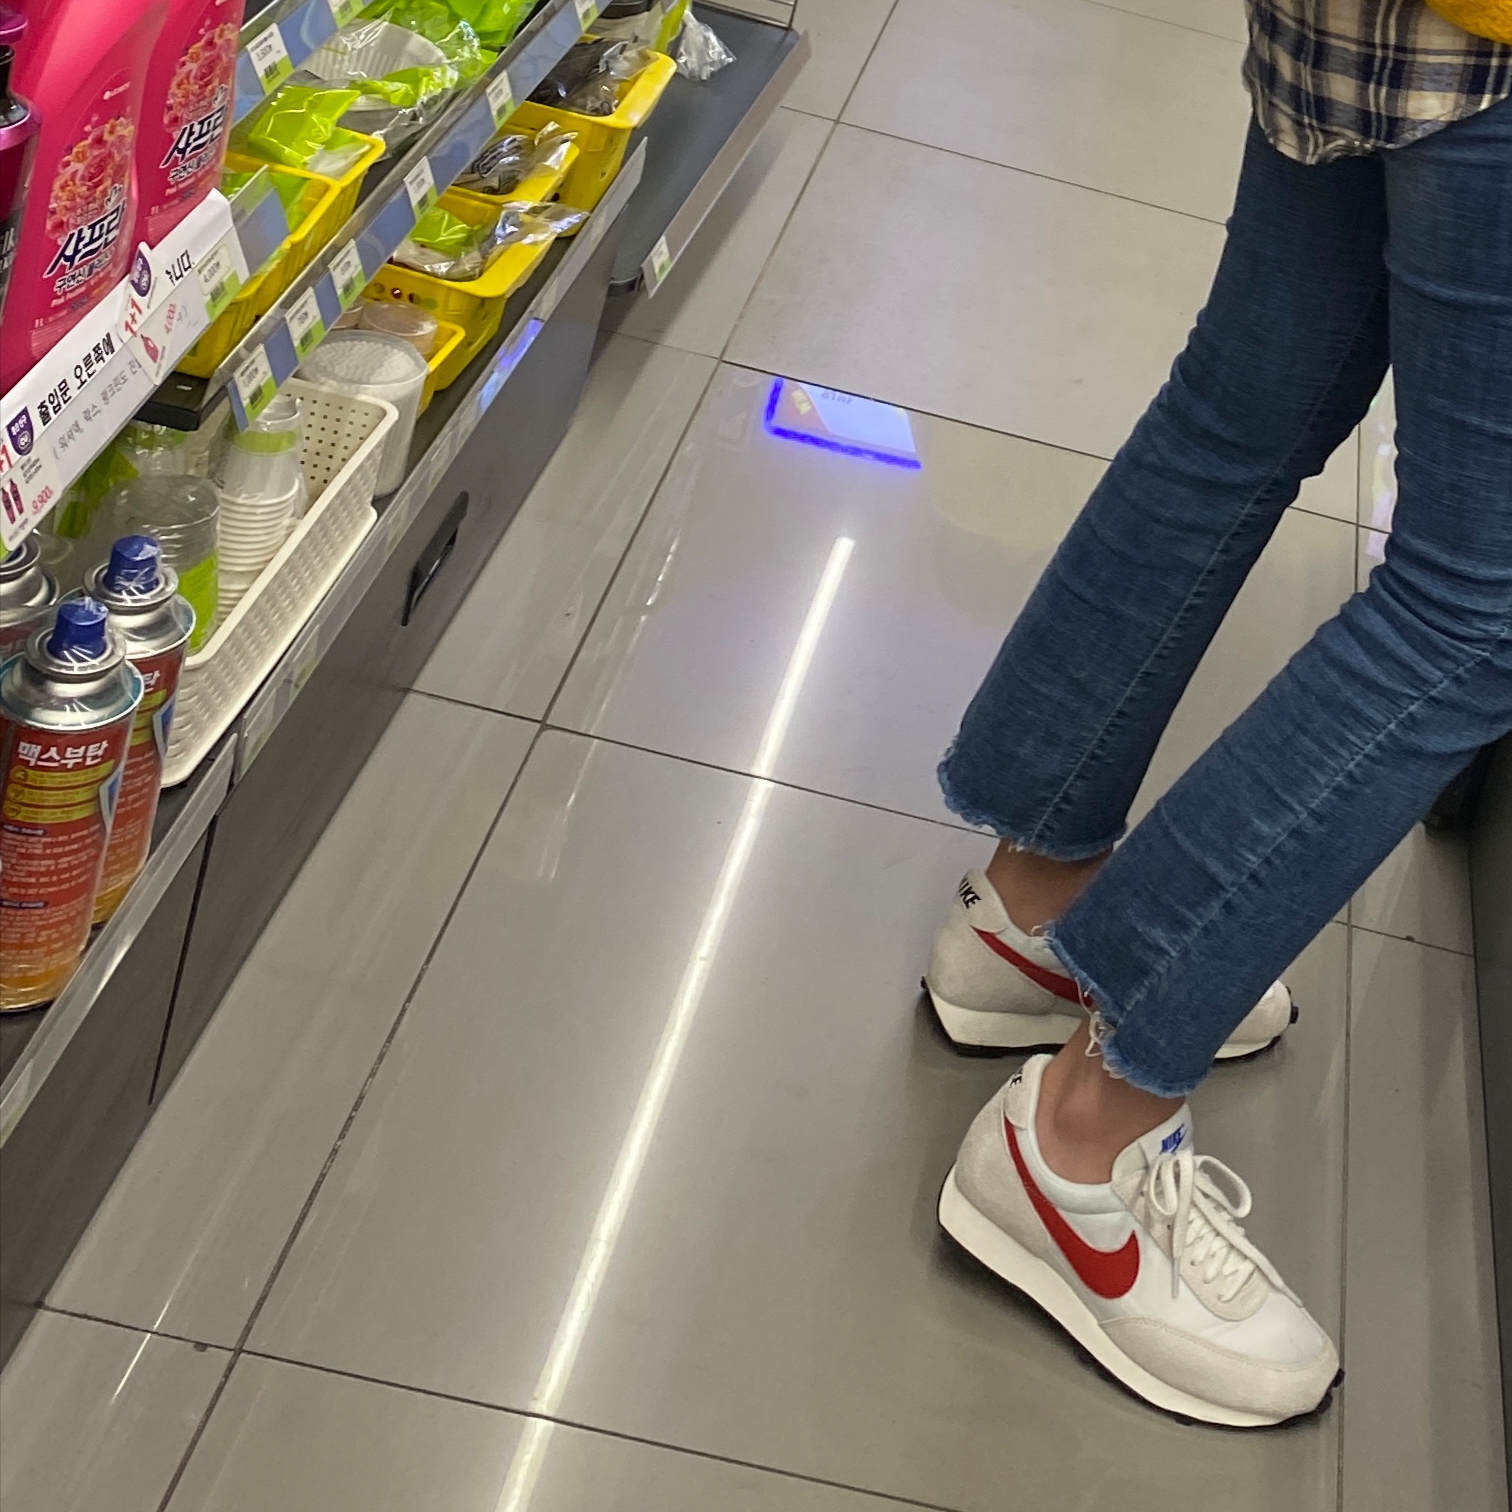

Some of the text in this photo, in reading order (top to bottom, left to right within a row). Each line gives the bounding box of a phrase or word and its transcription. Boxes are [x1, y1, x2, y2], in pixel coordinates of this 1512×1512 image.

[123, 297, 144, 338] 1+1
[37, 331, 117, 428] 출입문 오른쪽에
[0, 444, 13, 474] +1
[17, 740, 110, 768] 맥스부탄
